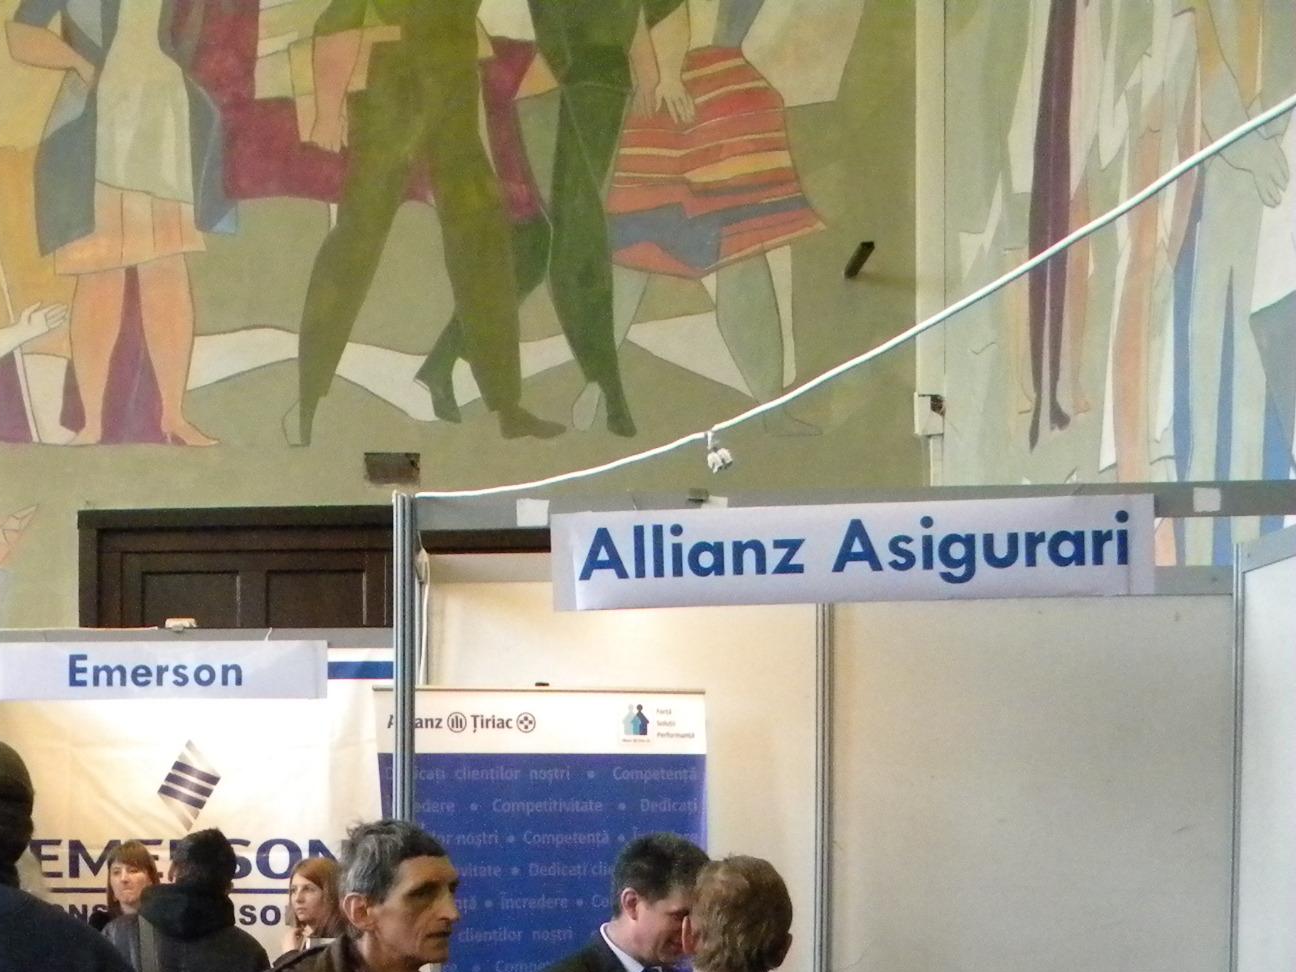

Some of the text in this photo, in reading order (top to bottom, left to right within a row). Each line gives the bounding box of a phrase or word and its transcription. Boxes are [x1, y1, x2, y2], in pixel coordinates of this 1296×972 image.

[578, 510, 1130, 584] Allianz Asigurari
[68, 653, 243, 687] Emerson
